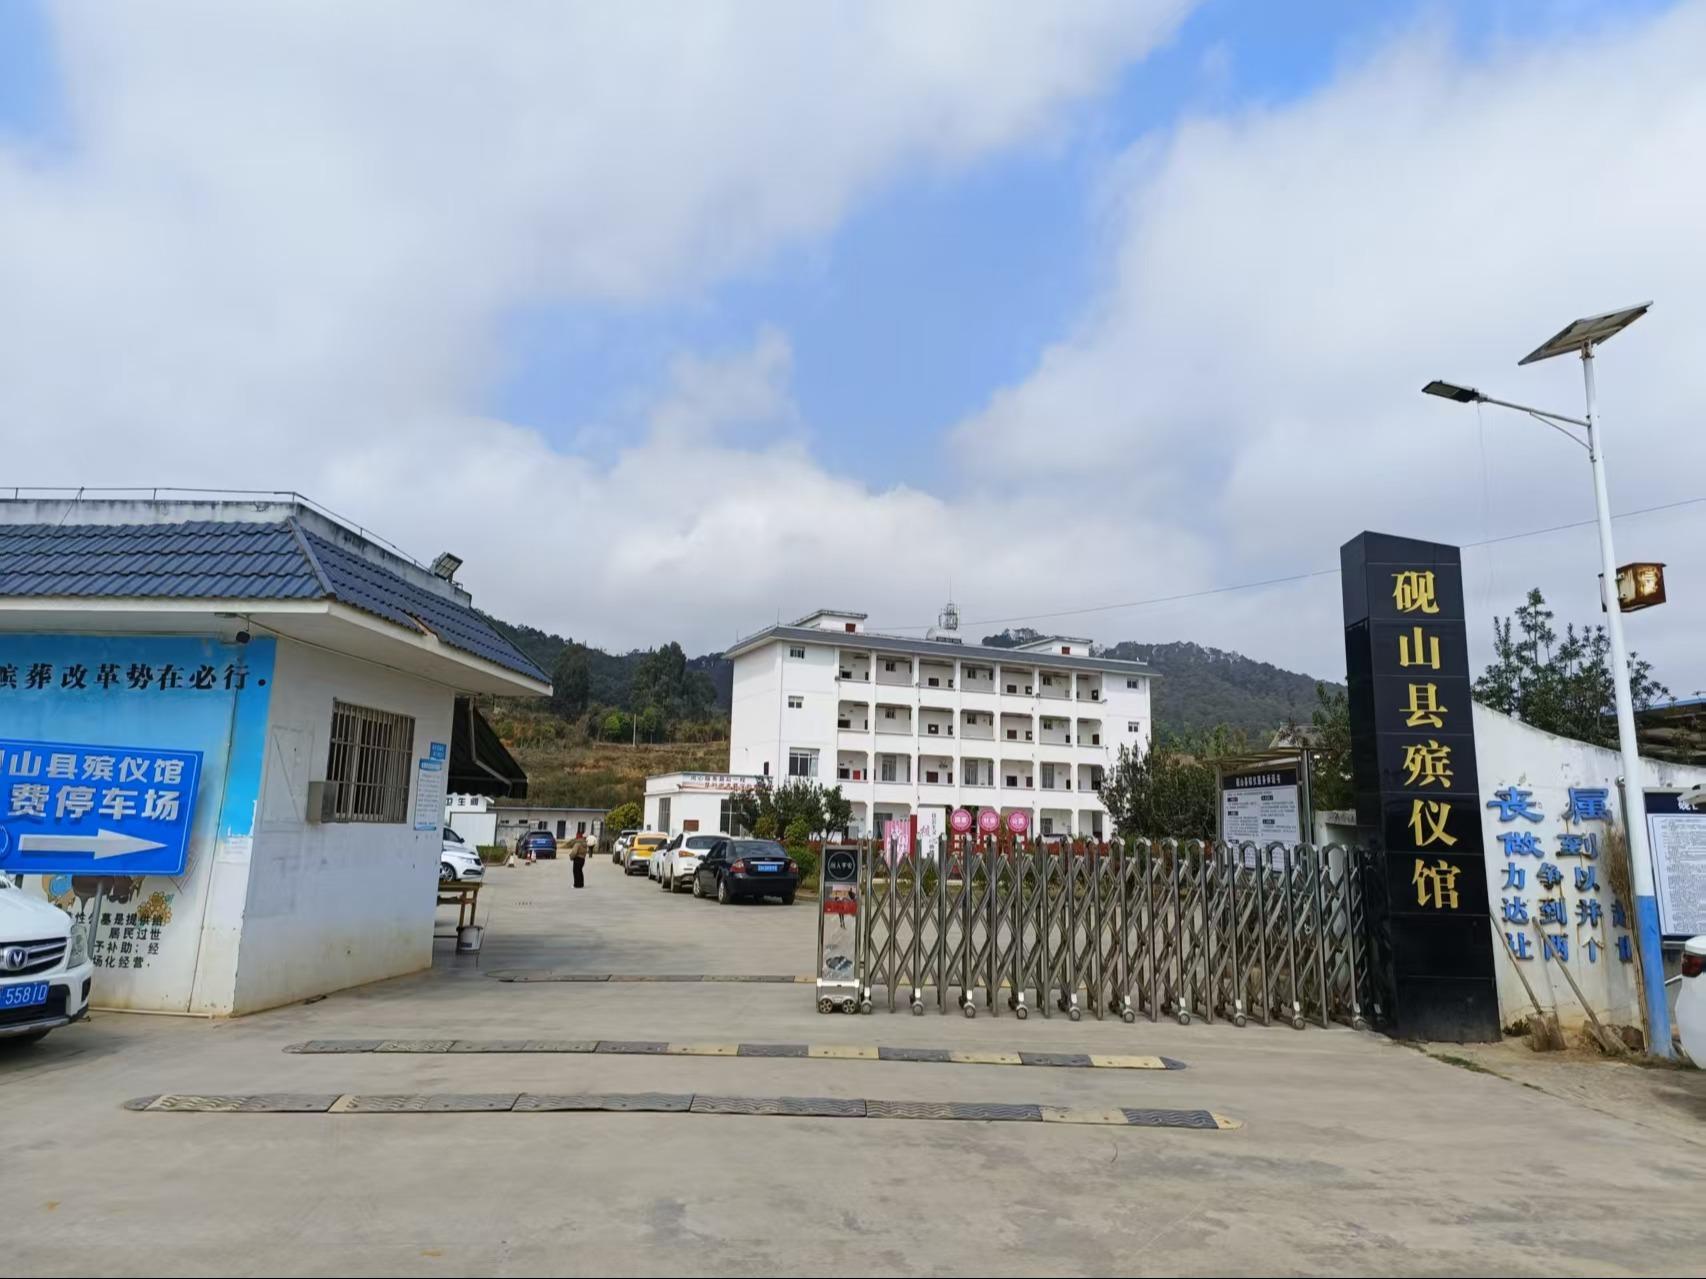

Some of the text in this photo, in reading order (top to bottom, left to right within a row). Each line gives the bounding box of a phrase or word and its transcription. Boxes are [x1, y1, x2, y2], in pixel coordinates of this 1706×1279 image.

[1391, 569, 1462, 910] 砚山县殡仪馆
[0, 749, 185, 785] 山县殡仪馆
[8, 783, 181, 822] 费停车场
[1496, 831, 1598, 860] 做到
[1501, 861, 1600, 892] 力争以
[109, 927, 162, 940] 居民过世
